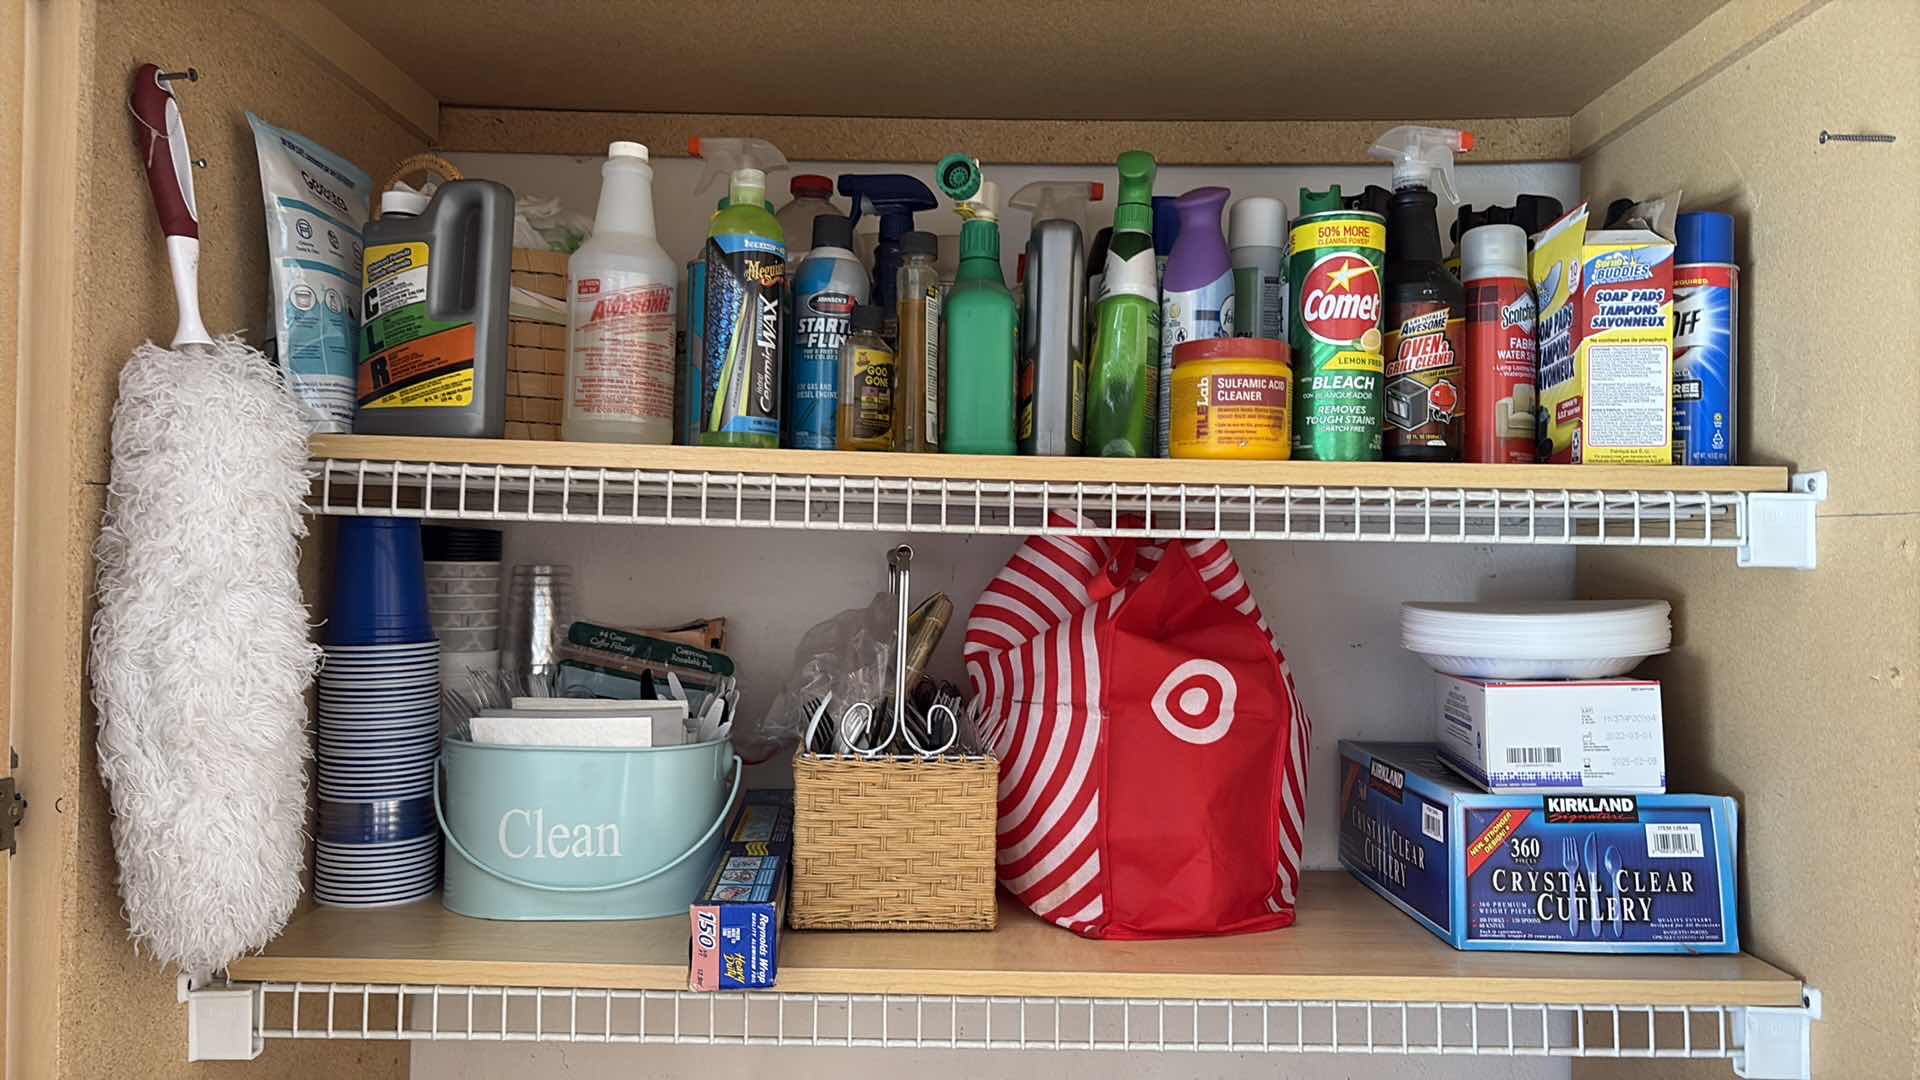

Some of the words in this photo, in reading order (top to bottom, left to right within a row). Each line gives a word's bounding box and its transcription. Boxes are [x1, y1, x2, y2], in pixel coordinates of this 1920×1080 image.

[1318, 226, 1340, 238] 50%
[1343, 225, 1370, 237] MORE
[1597, 265, 1650, 280] BUDDIES
[1672, 278, 1709, 287] EQUIRED
[364, 287, 379, 320] C
[1596, 291, 1628, 302] SOAP
[1632, 290, 1664, 302] PADS
[591, 297, 671, 322] AWESOME
[1303, 289, 1380, 322] Comet
[1600, 304, 1658, 316] TAMPONS
[757, 292, 779, 350] WAX
[1502, 302, 1537, 329] Scotch
[1592, 316, 1666, 328] SAVONNEUX
[798, 317, 856, 334] STARTI
[1401, 317, 1446, 336] AWESOME
[808, 333, 847, 348] FLU
[1399, 335, 1441, 361] OVEN
[1510, 337, 1537, 350] FABRI
[1338, 358, 1366, 366] LEMON
[1386, 358, 1413, 376] GRILL
[1415, 352, 1453, 369] CLEANER
[1497, 350, 1527, 361] WATER
[370, 355, 390, 390] R
[866, 365, 888, 377] GOO
[1540, 355, 1575, 391] AVONNEUX
[864, 376, 889, 388] GONE
[1217, 377, 1267, 390] SULFAMIC
[1268, 379, 1286, 391] ACID
[1312, 375, 1375, 390] BLEACH
[1672, 382, 1700, 394] REE
[1217, 390, 1262, 401] CLEANER
[1319, 405, 1367, 414] REMOVES
[1305, 416, 1343, 426] TOUGH
[1344, 416, 1376, 425] STAINS
[1370, 759, 1404, 791] KIRKLAND
[1548, 797, 1634, 813] KIRKLAND
[1550, 812, 1638, 823] Signature
[498, 808, 622, 859] Clean
[1391, 829, 1426, 871] CLEAR
[1510, 838, 1540, 858] 360
[1492, 868, 1602, 892] CRYSTAL
[1615, 869, 1694, 892] CLEAR
[1537, 892, 1652, 921] CUTLERY
[698, 911, 716, 949] 150
[759, 913, 769, 957] Reynolds
[723, 953, 737, 982] Duty
[734, 952, 746, 984] Heavy
[758, 957, 769, 984] Wrap
